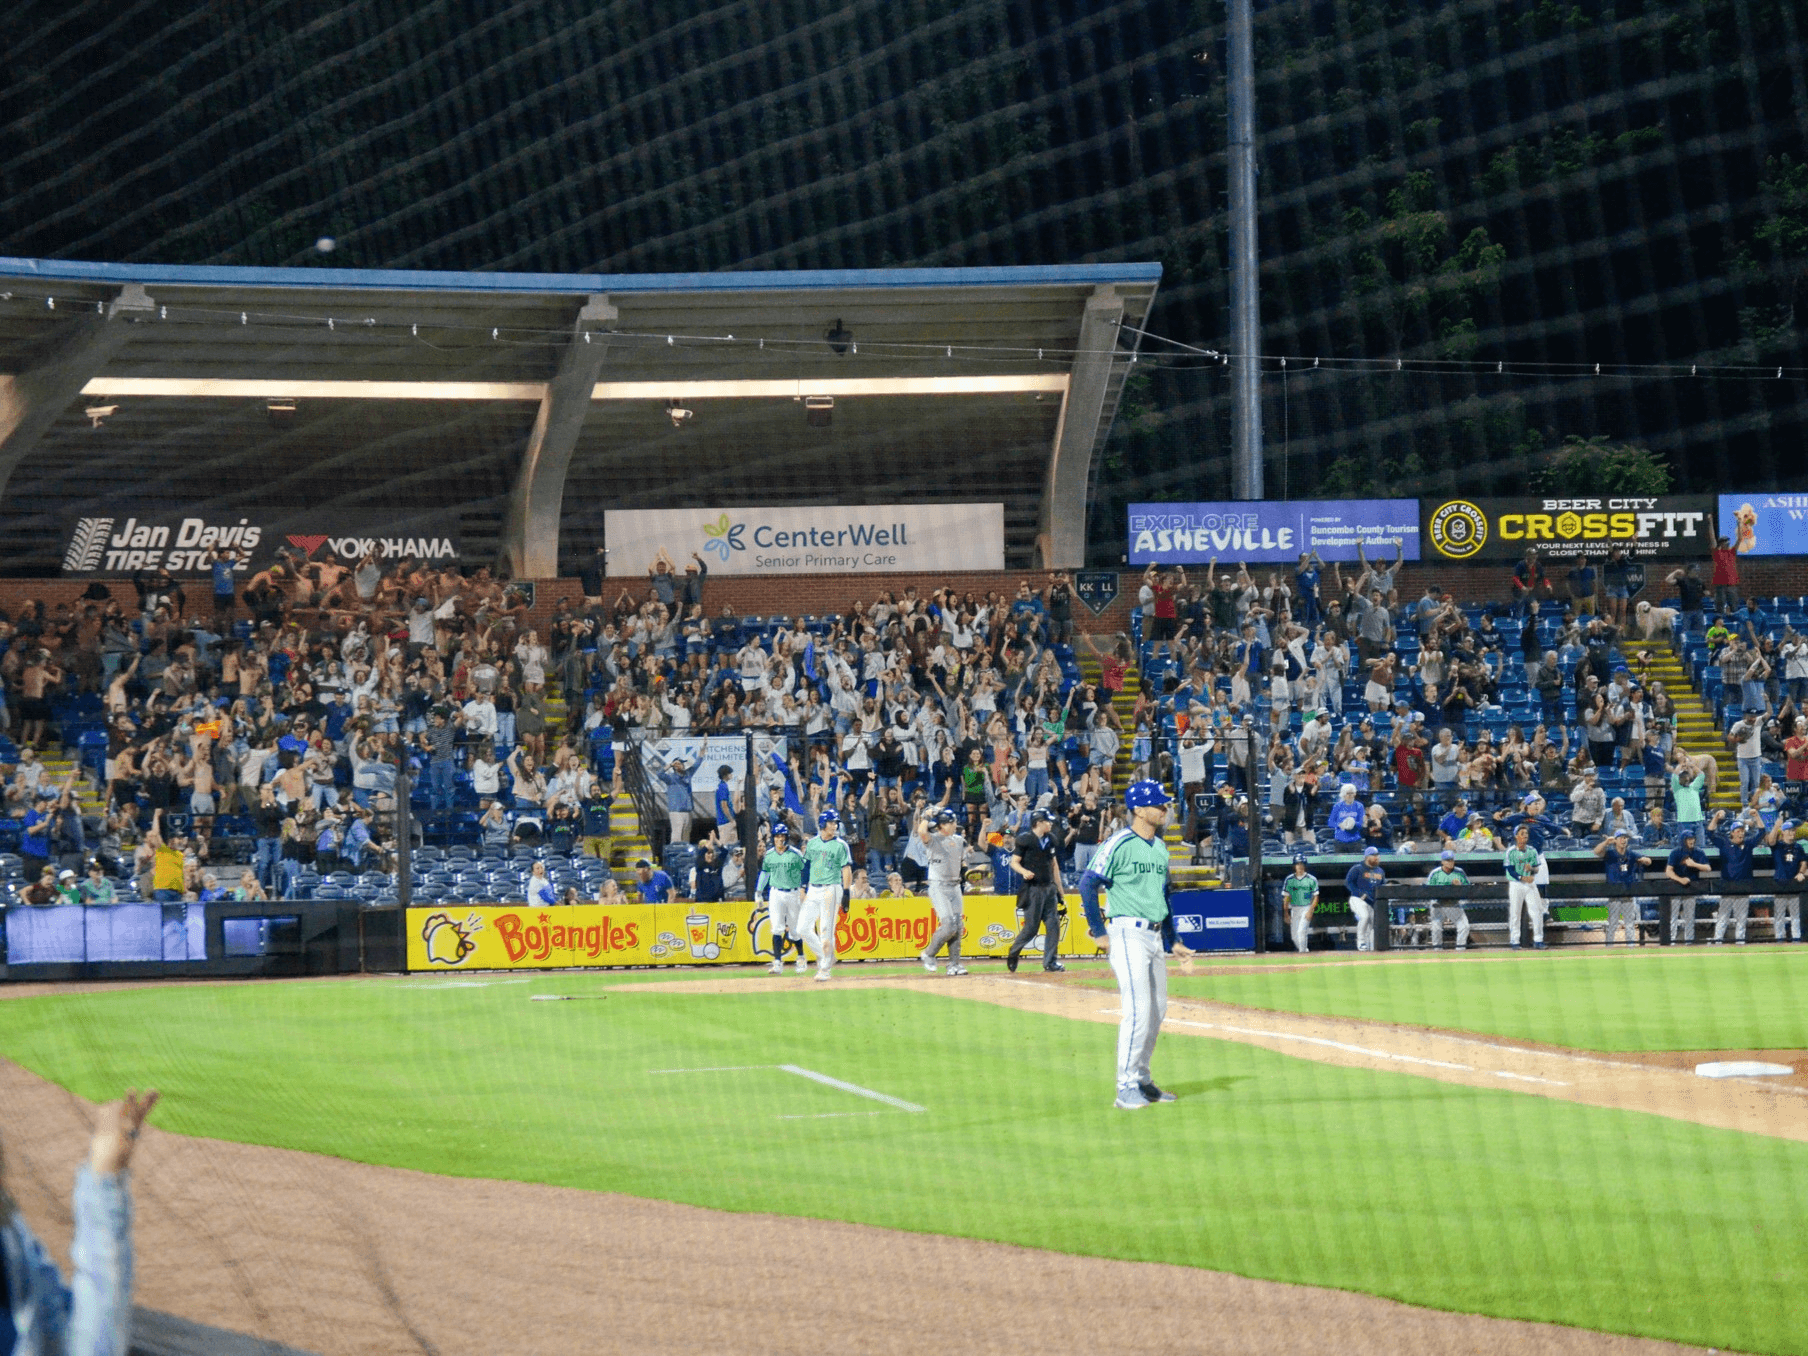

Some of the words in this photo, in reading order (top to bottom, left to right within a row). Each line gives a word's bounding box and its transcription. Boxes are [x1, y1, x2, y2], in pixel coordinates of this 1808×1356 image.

[1543, 500, 1602, 510] BEER
[1609, 499, 1657, 509] CITY
[110, 517, 171, 549] Jan
[175, 517, 262, 549] Davis
[1130, 514, 1259, 533] EXPLORE
[1311, 525, 1355, 534] Buncombe
[1356, 525, 1385, 535] County
[1386, 524, 1419, 533] Tourism
[1434, 518, 1443, 540] BEER
[1440, 505, 1457, 518] CITY
[1460, 505, 1484, 540] CROSSFIT
[1498, 511, 1704, 540] CROSSFIT
[754, 523, 908, 548] CenterWell
[1134, 528, 1294, 553] ASHEVILLE
[327, 538, 456, 559] YOKOHAMA
[104, 550, 164, 571] TIRE
[165, 550, 253, 571] STOE
[756, 555, 801, 568] Senior
[805, 554, 859, 569] Primary
[863, 553, 896, 566] Care
[1079, 583, 1094, 591] KK
[1102, 583, 1113, 591] LL
[493, 911, 640, 963] Bojangles
